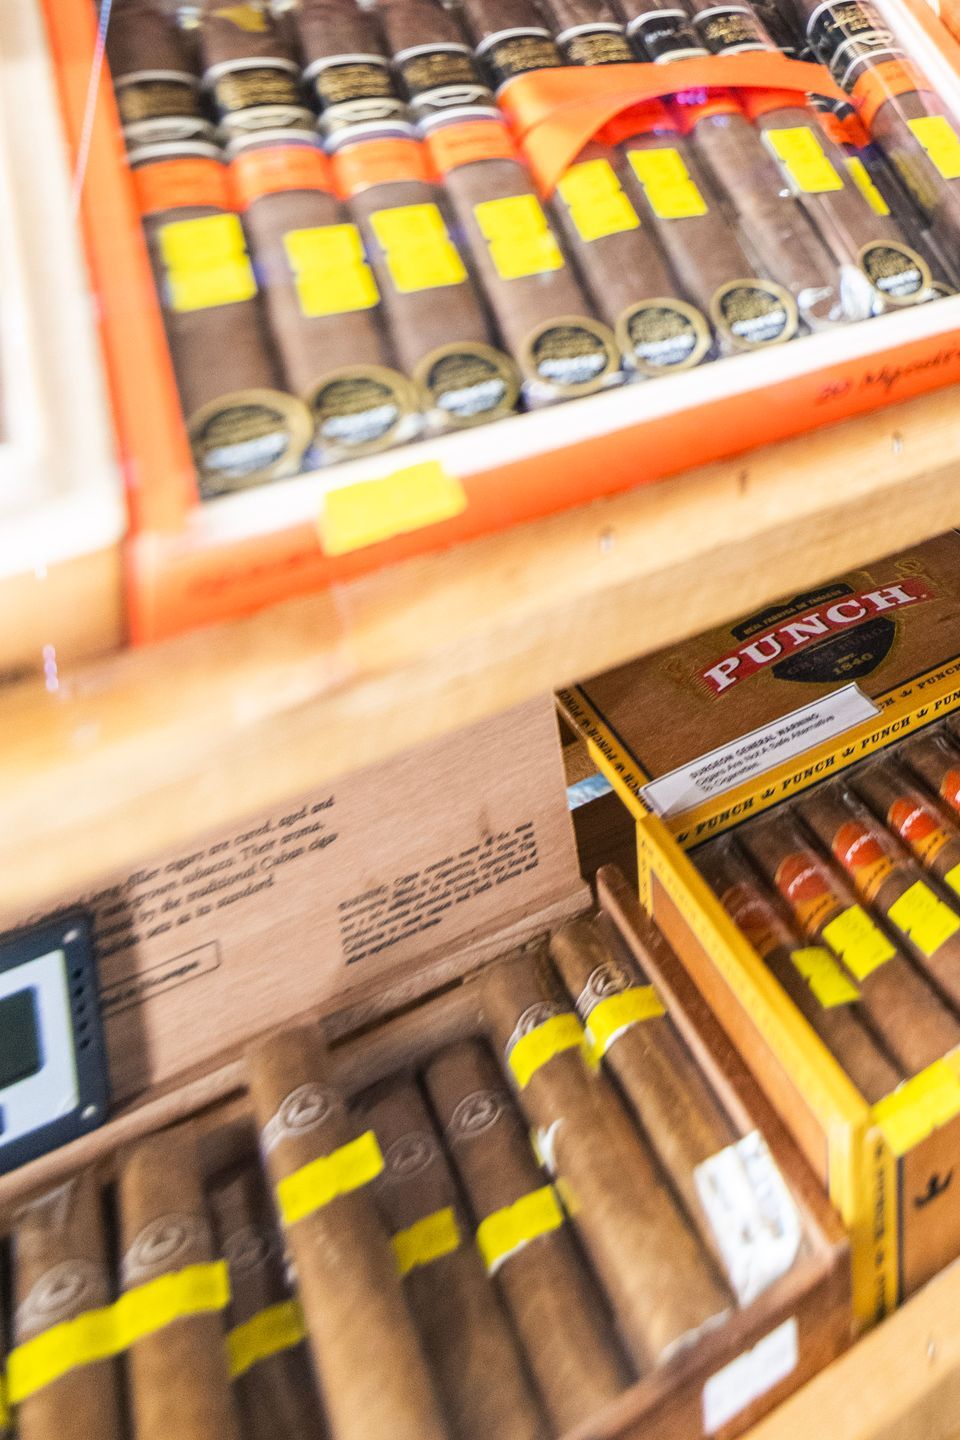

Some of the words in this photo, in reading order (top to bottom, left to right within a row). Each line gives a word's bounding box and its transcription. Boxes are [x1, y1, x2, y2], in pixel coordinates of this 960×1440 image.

[702, 584, 918, 694] PUNCH
[861, 716, 911, 751] PUNCH
[782, 755, 836, 799] PUNCH
[695, 796, 756, 837] PUNCH
